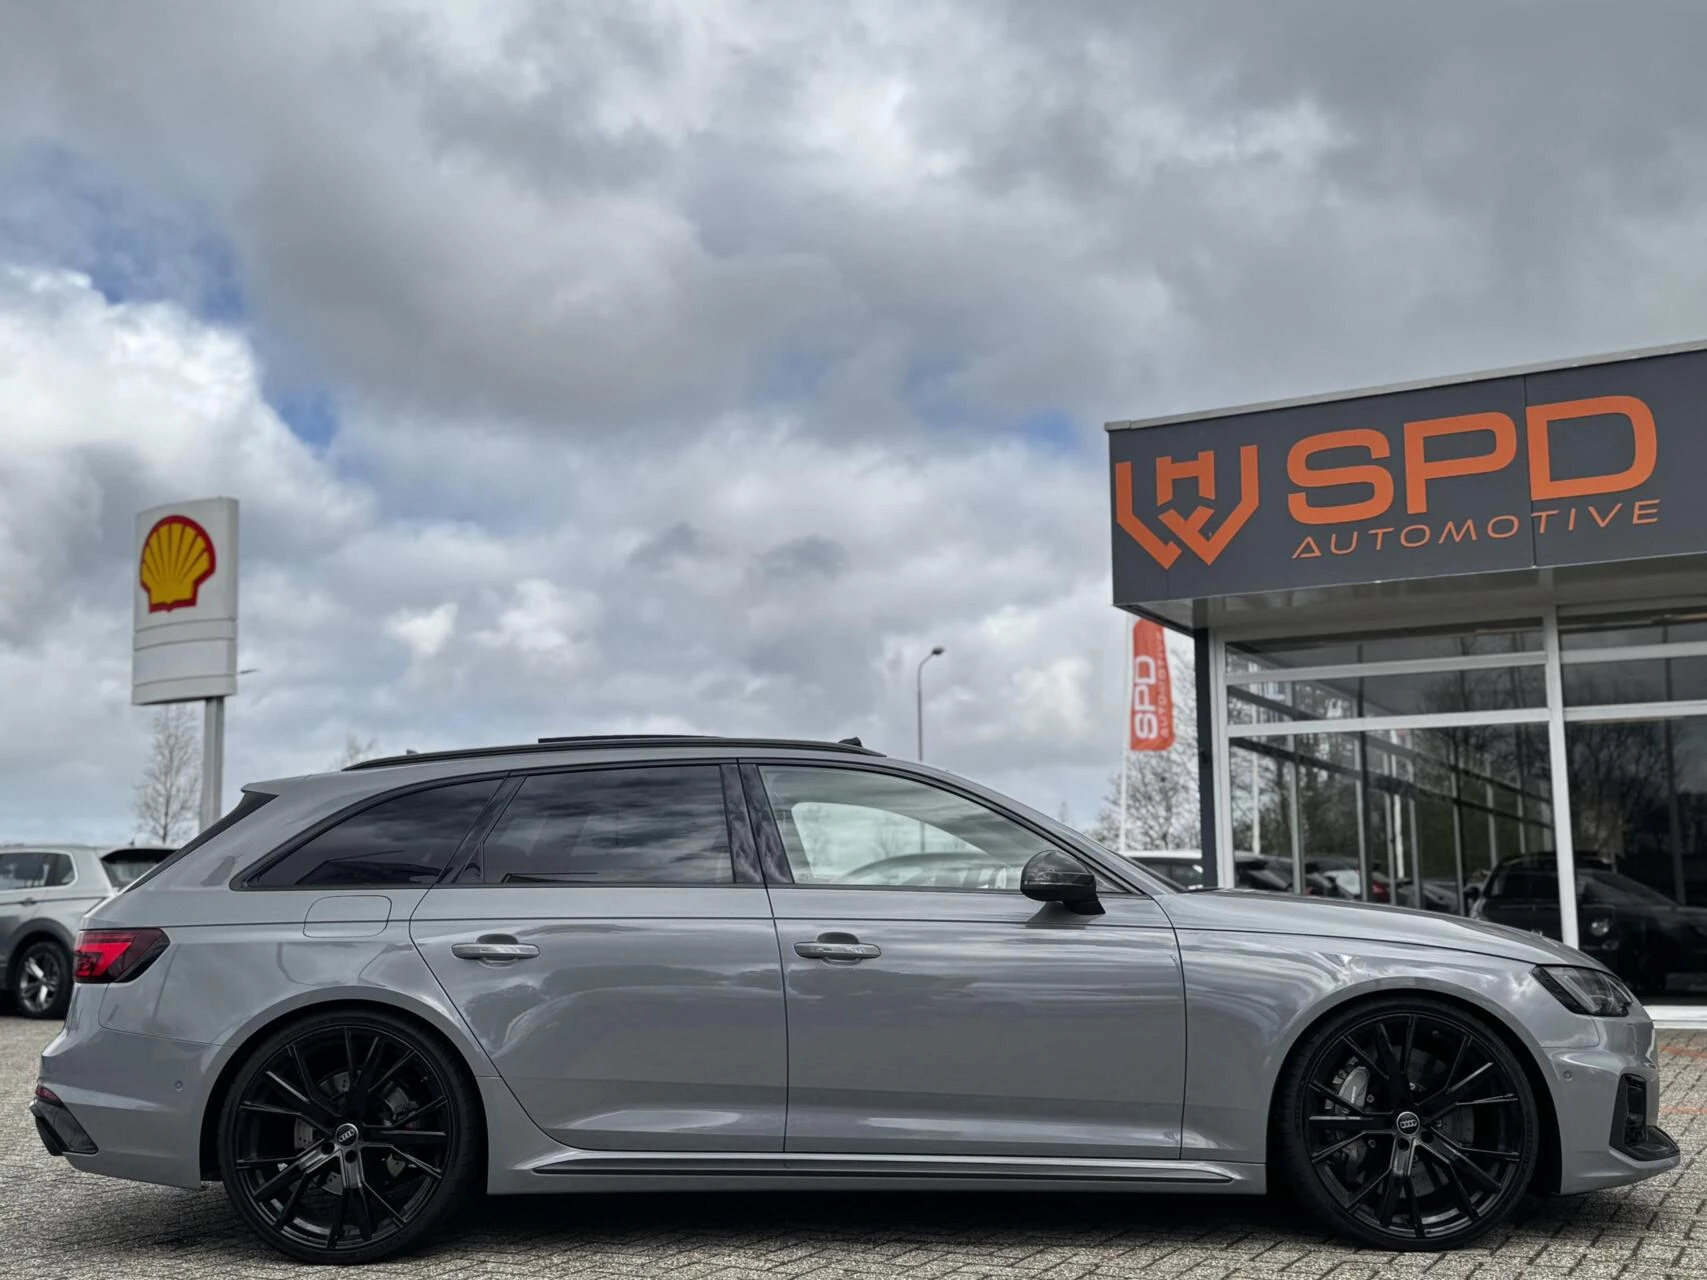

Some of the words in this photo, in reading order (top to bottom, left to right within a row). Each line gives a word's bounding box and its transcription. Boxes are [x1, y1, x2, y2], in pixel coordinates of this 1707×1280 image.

[1287, 396, 1658, 526] SPD
[1291, 499, 1660, 559] AUTOMOTIVE
[1134, 655, 1158, 739] SPD
